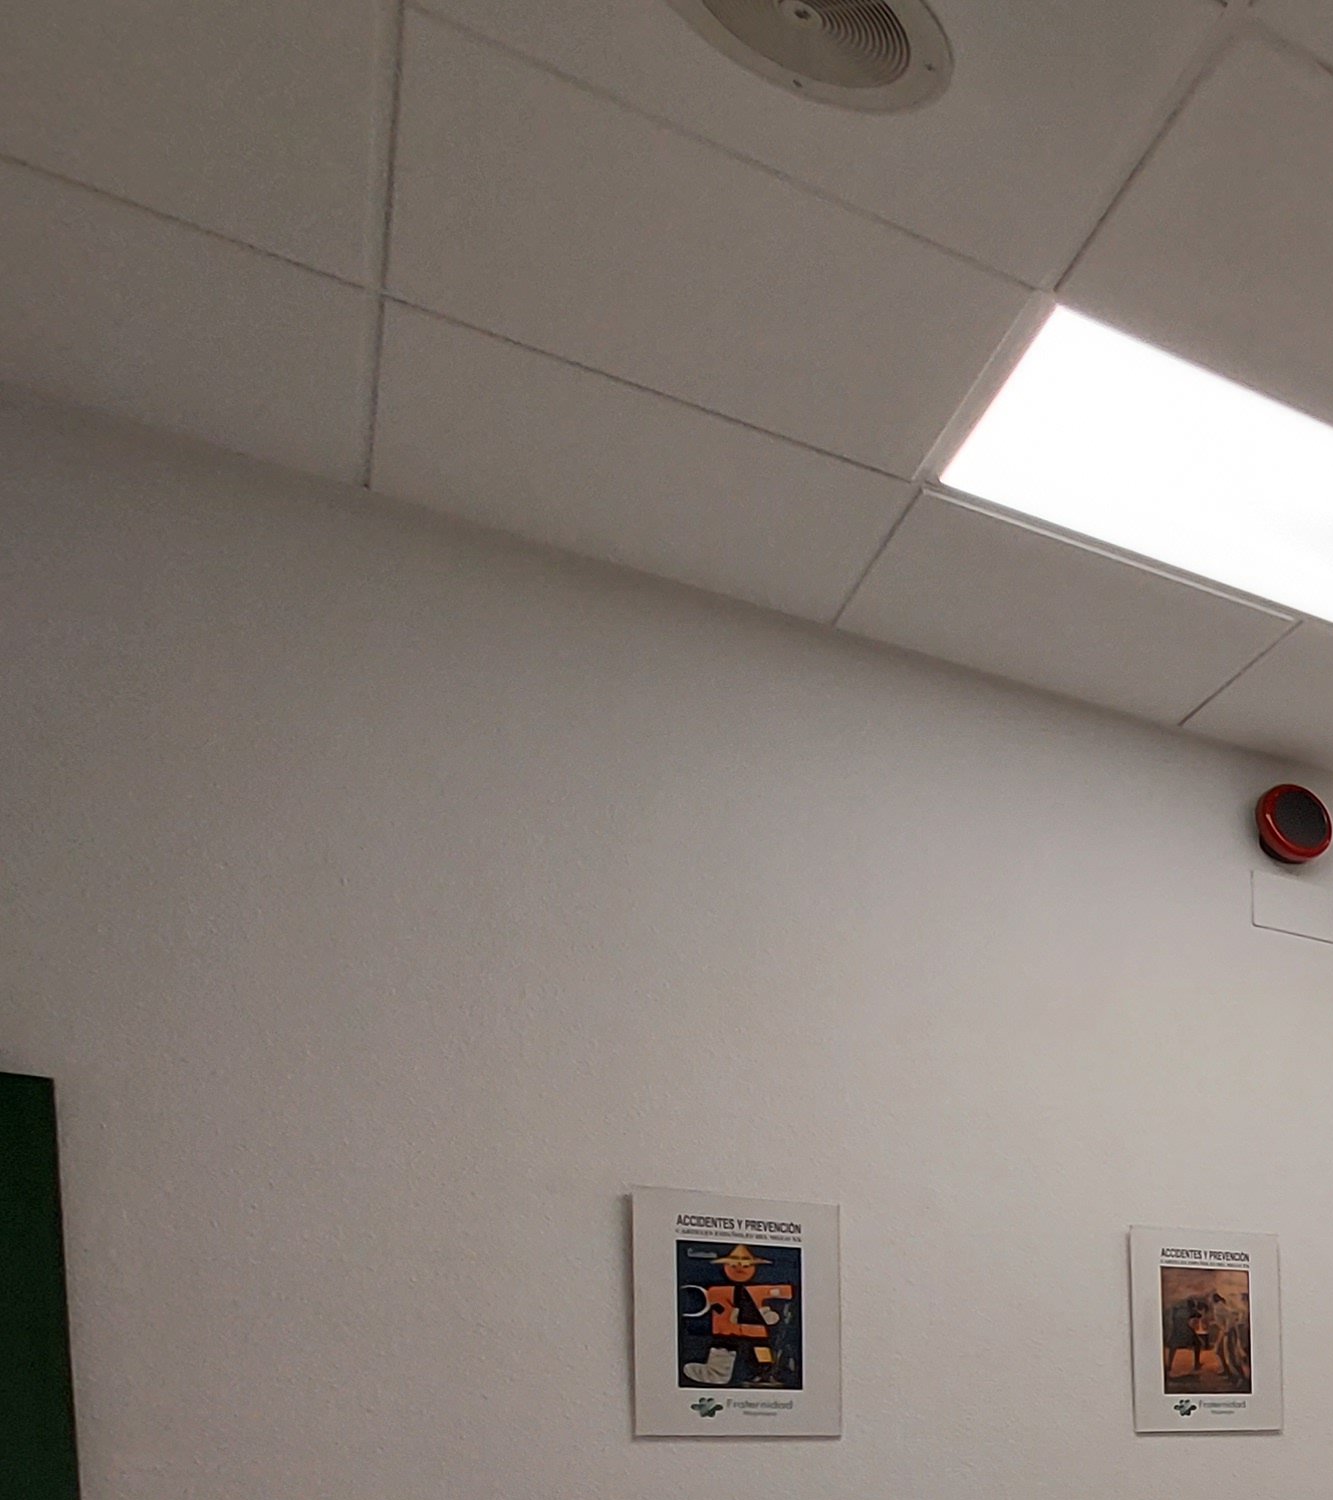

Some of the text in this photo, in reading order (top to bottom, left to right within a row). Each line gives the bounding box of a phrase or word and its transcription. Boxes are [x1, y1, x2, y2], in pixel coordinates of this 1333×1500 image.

[676, 1214, 802, 1235] ACCIDENTES Y PREVENCIÓN
[1160, 1248, 1203, 1260] ACCIDENTES
[1208, 1250, 1250, 1263] PREVENCIÓN
